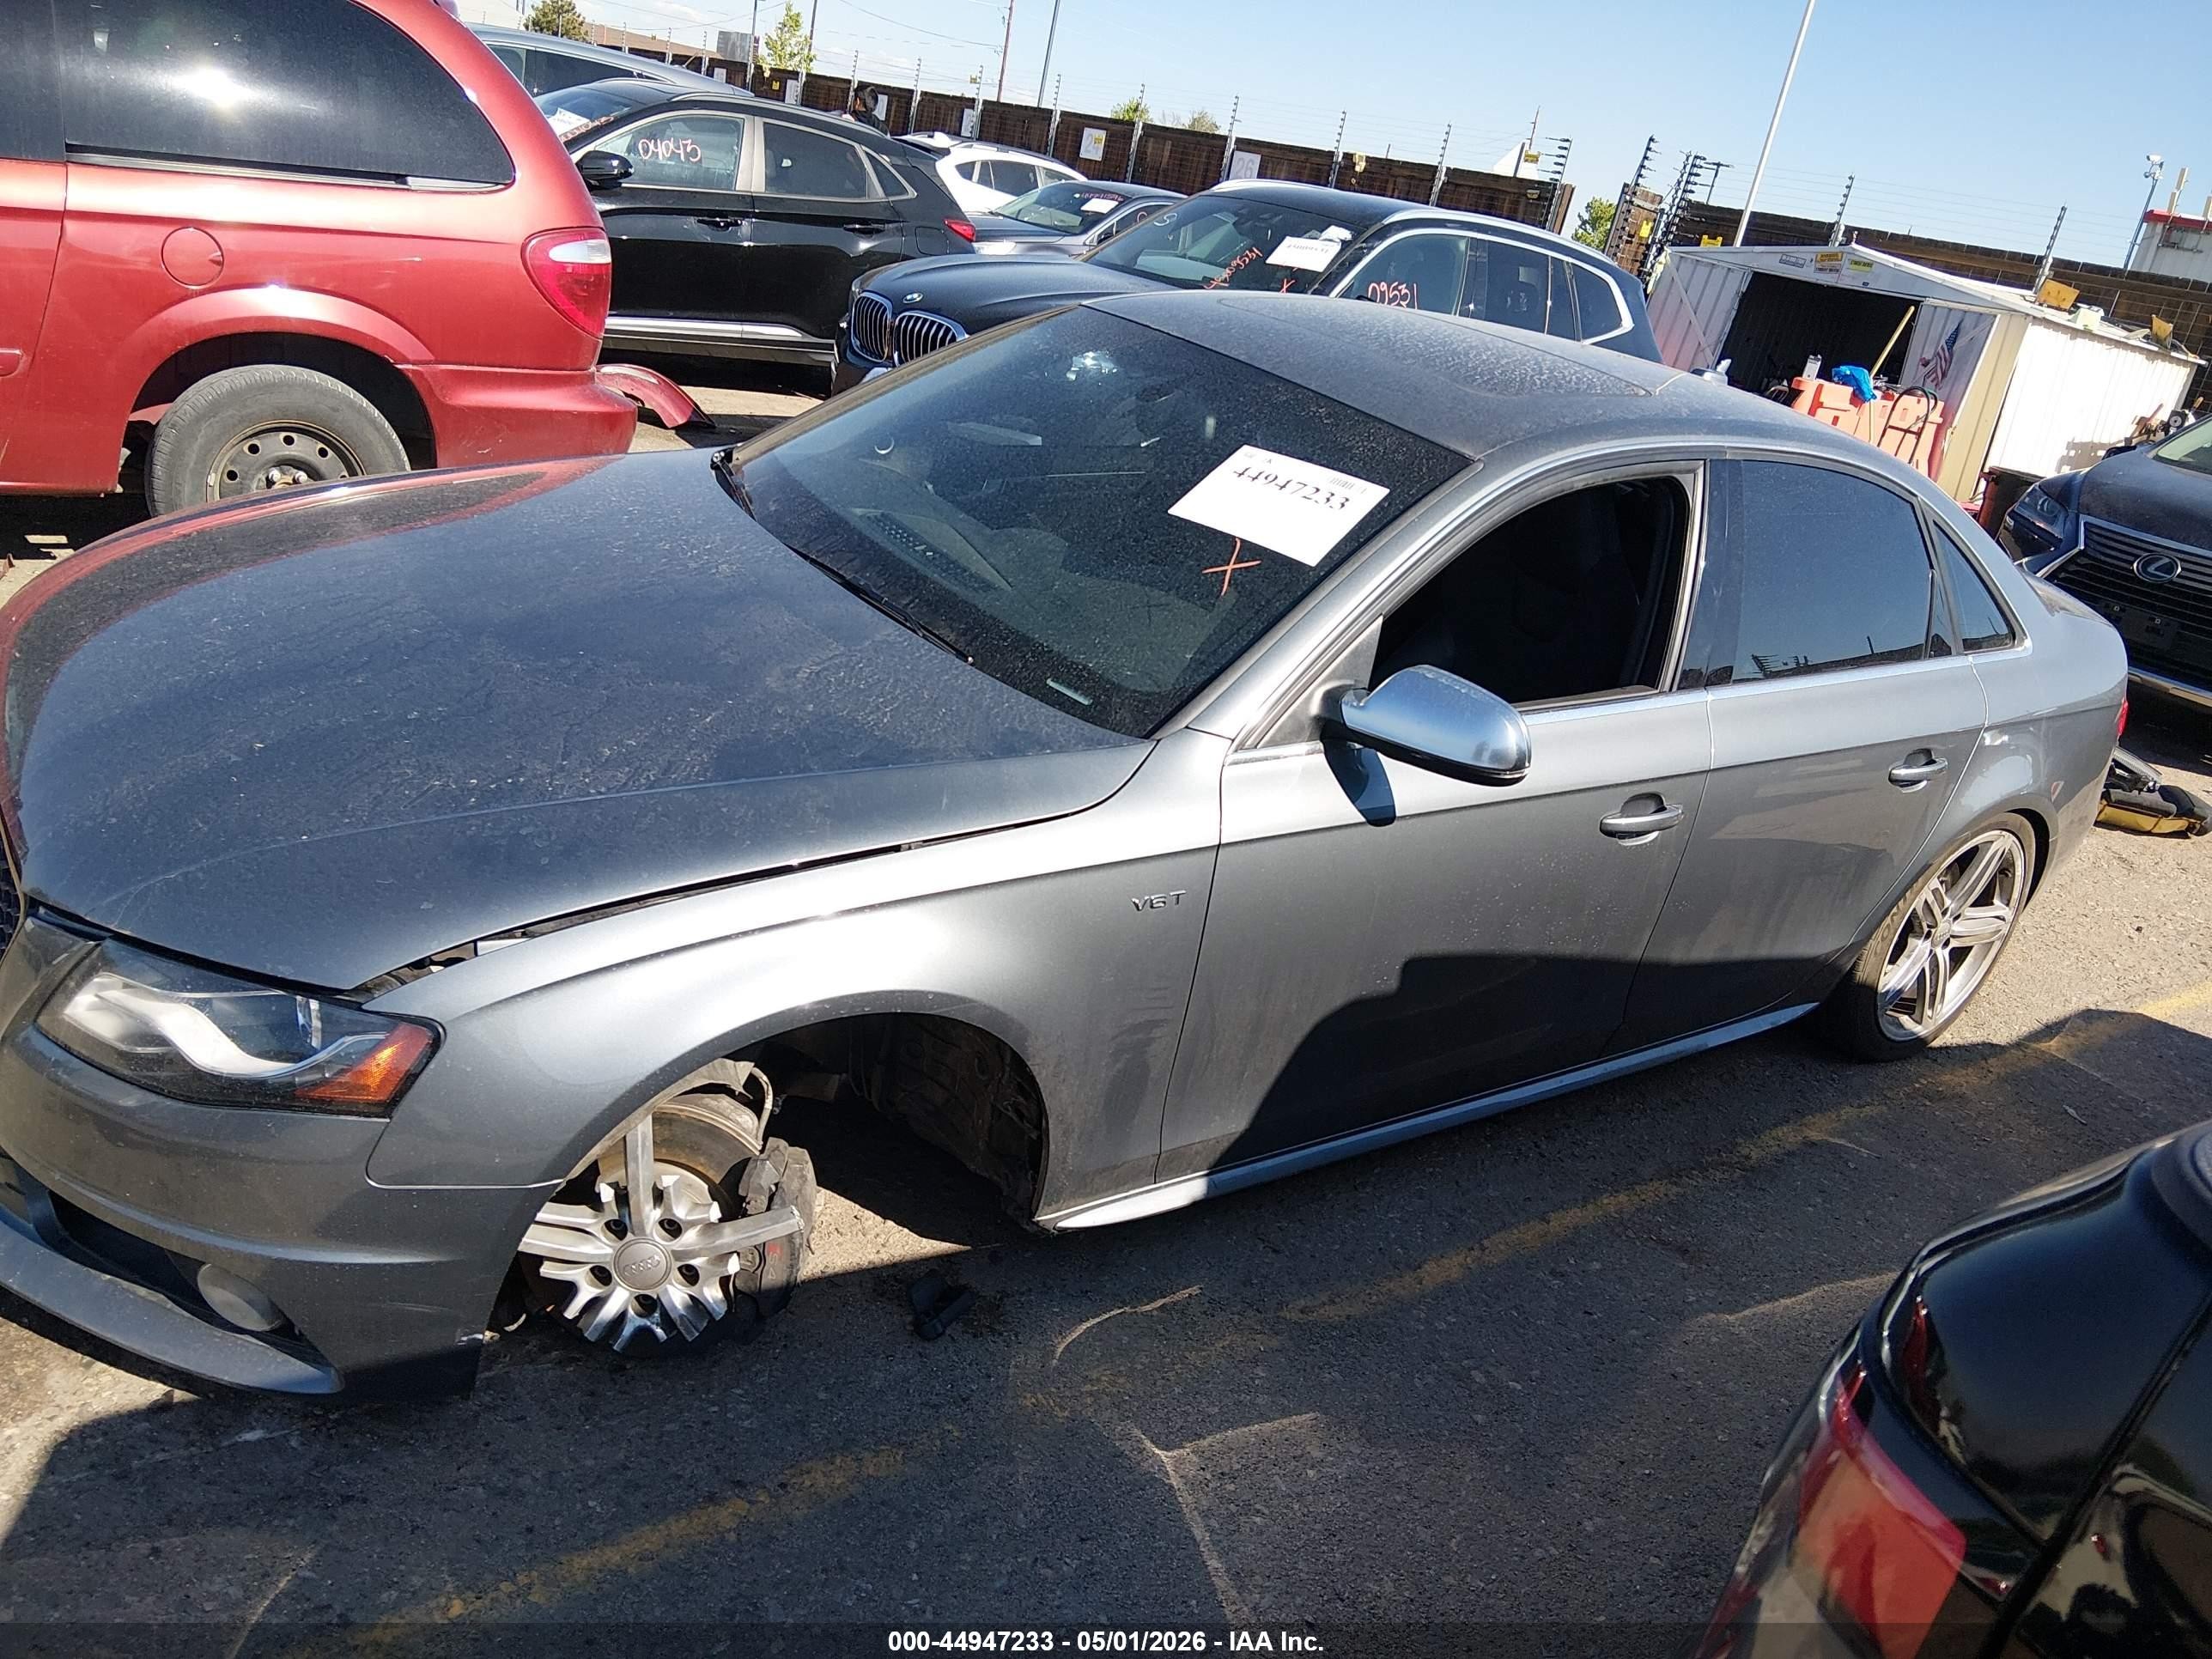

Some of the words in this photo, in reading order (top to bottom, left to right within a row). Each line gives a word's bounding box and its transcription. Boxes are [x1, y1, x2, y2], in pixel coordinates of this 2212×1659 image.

[638, 137, 702, 161] 04043
[1233, 466, 1351, 510] 44947233
[1131, 890, 1187, 912] V6T
